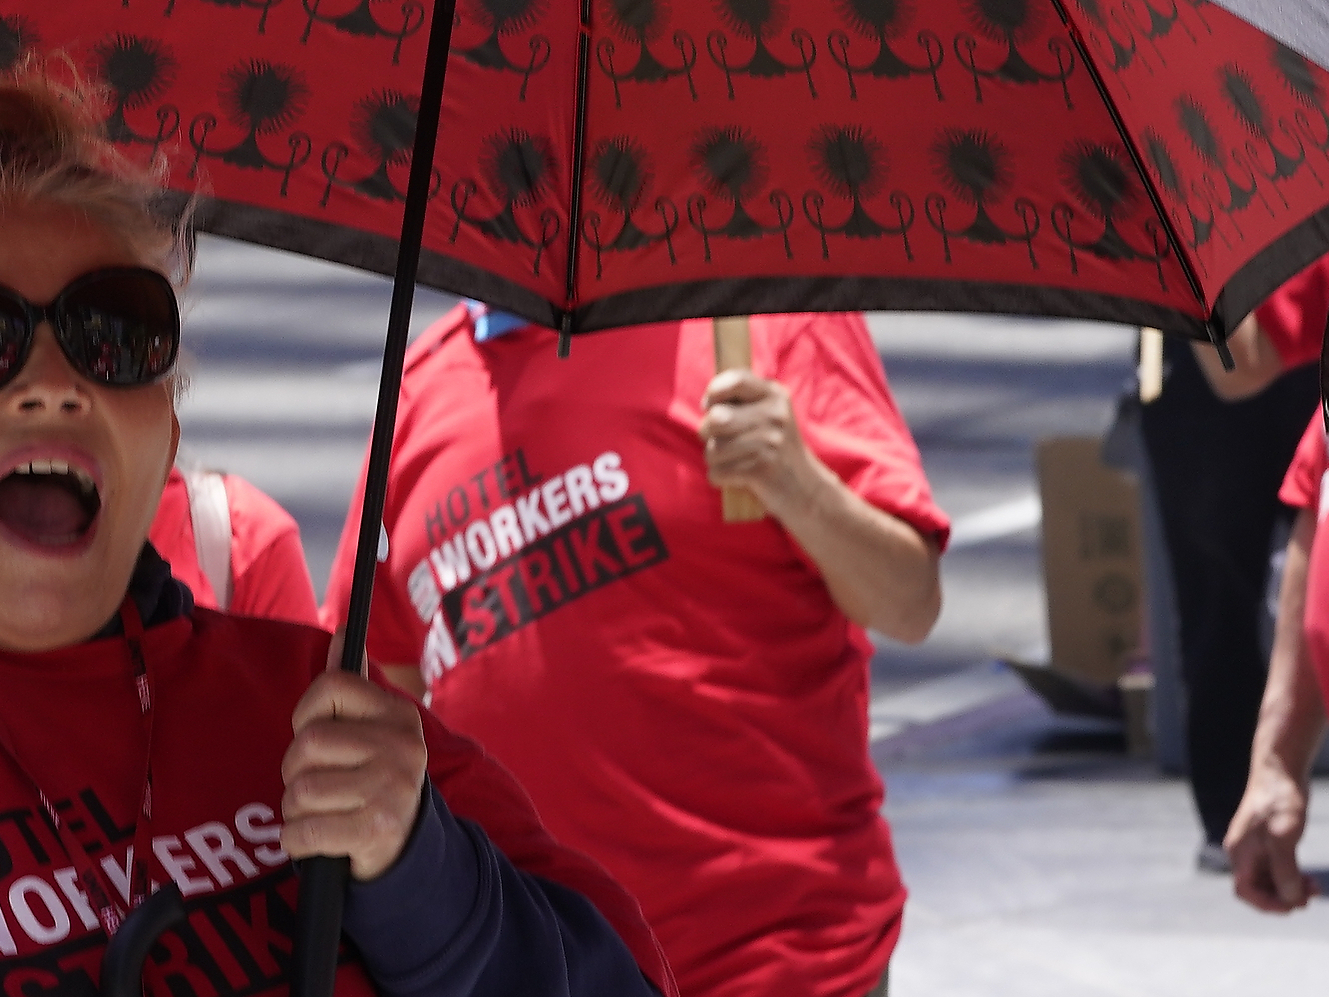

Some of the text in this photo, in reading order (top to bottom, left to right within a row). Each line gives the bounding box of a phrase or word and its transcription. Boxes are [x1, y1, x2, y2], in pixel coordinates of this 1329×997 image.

[424, 445, 544, 545] HOTEL
[429, 450, 630, 592] WORKERS
[458, 504, 659, 647] STRIKE
